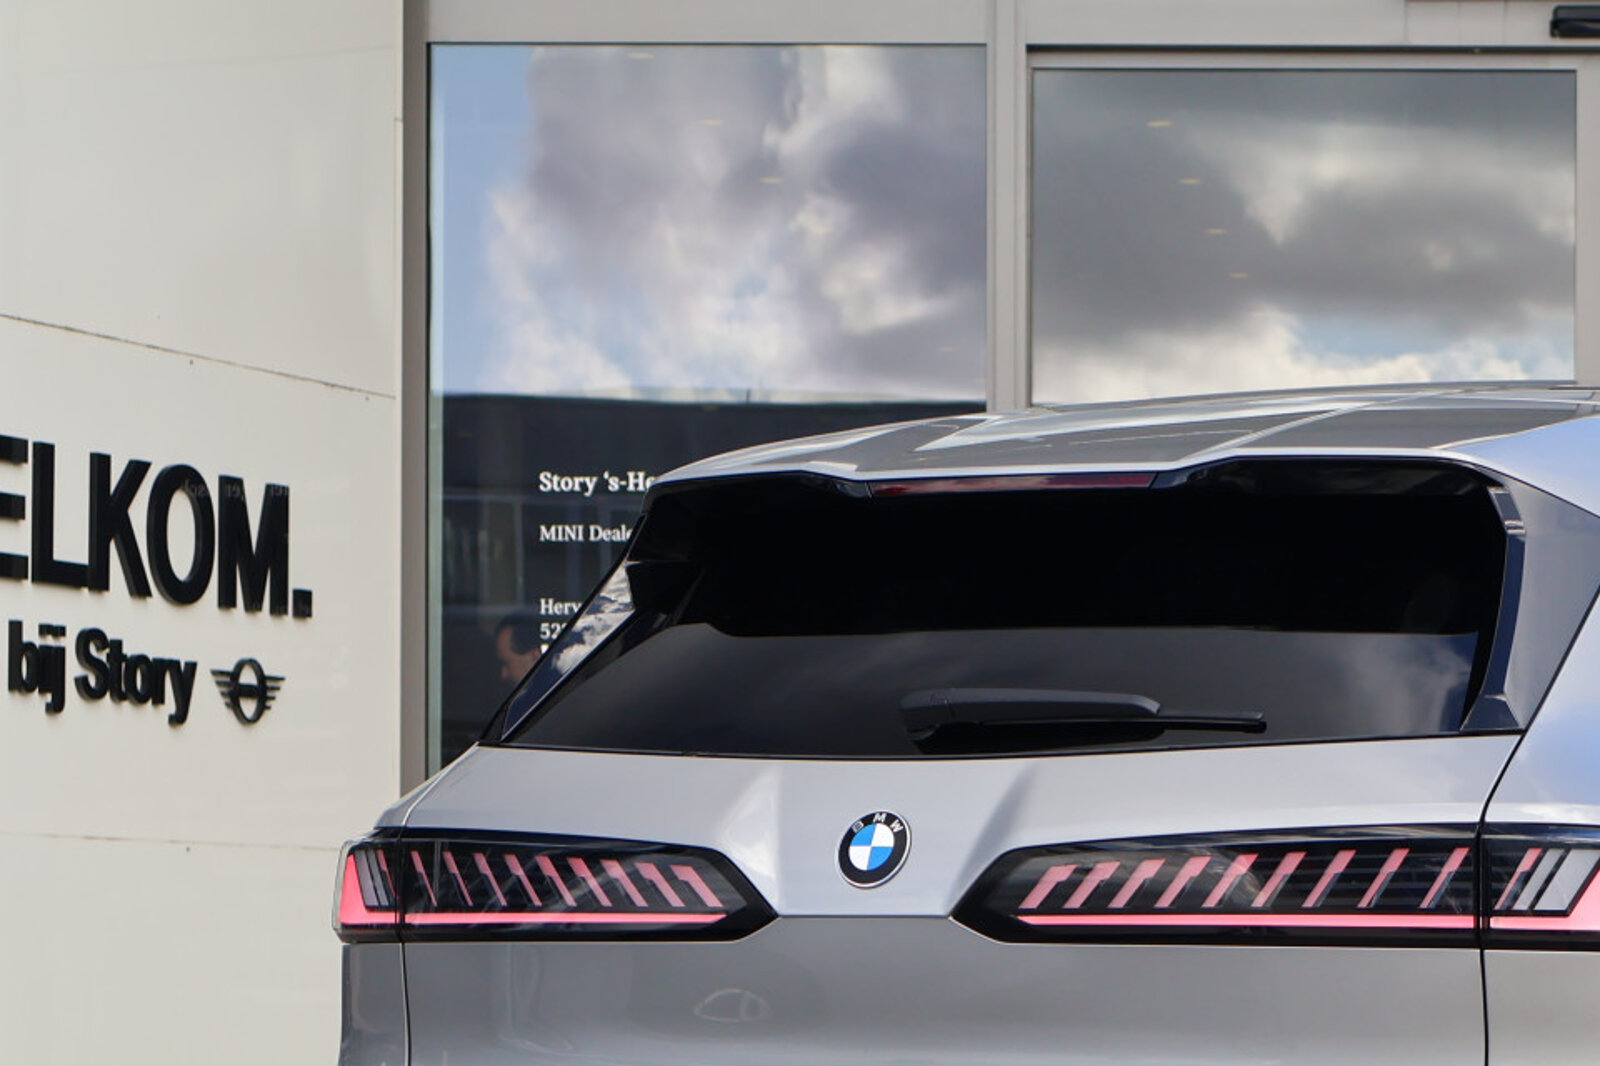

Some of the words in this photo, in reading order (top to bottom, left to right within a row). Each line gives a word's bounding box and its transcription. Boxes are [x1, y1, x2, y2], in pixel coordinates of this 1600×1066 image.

[539, 471, 598, 497] Story
[539, 524, 584, 542] MINI
[8, 619, 66, 714] bij
[74, 628, 198, 725] Story
